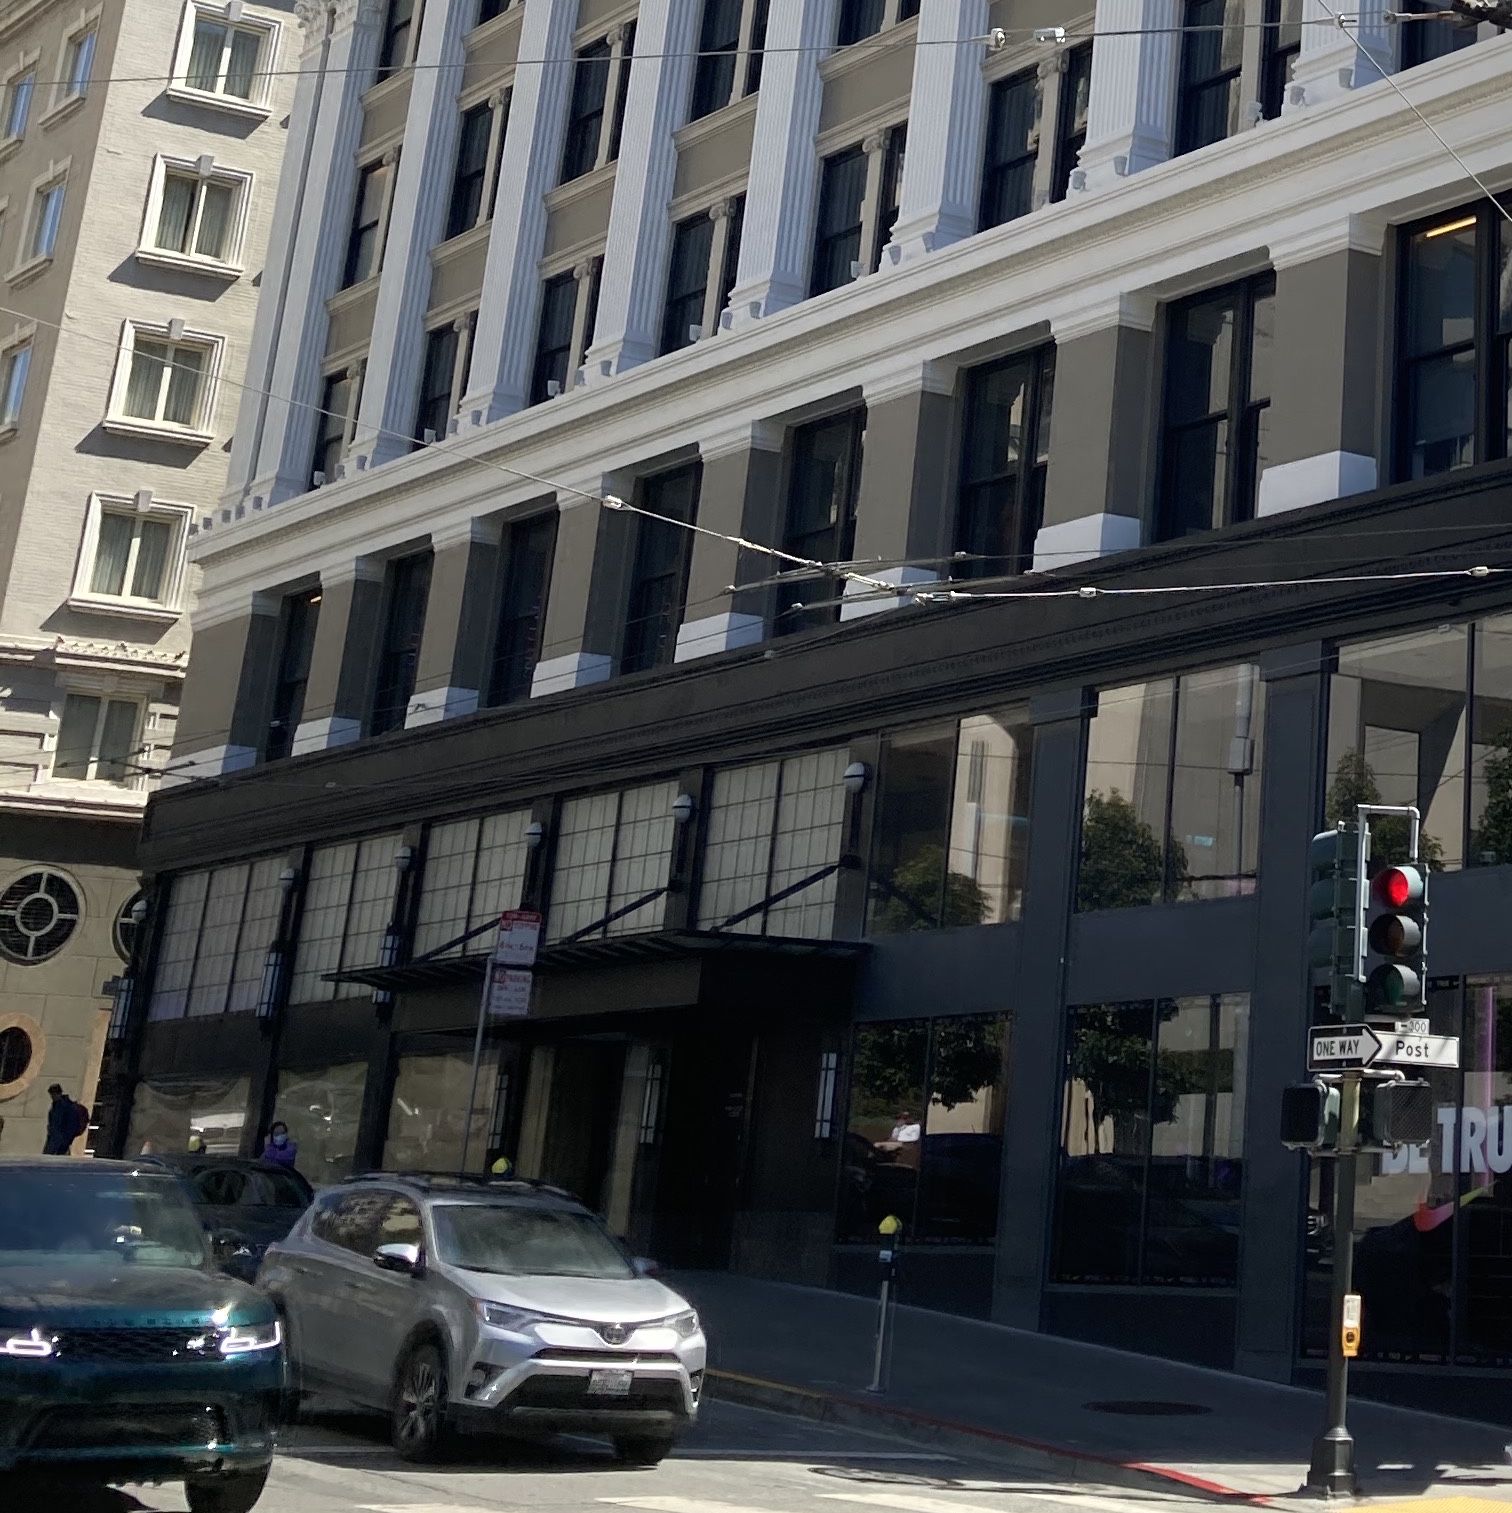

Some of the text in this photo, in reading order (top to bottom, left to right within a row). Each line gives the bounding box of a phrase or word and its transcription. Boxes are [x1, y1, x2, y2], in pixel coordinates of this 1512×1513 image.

[1316, 1039, 1360, 1056] ONE WAY
[1395, 1040, 1429, 1058] Post
